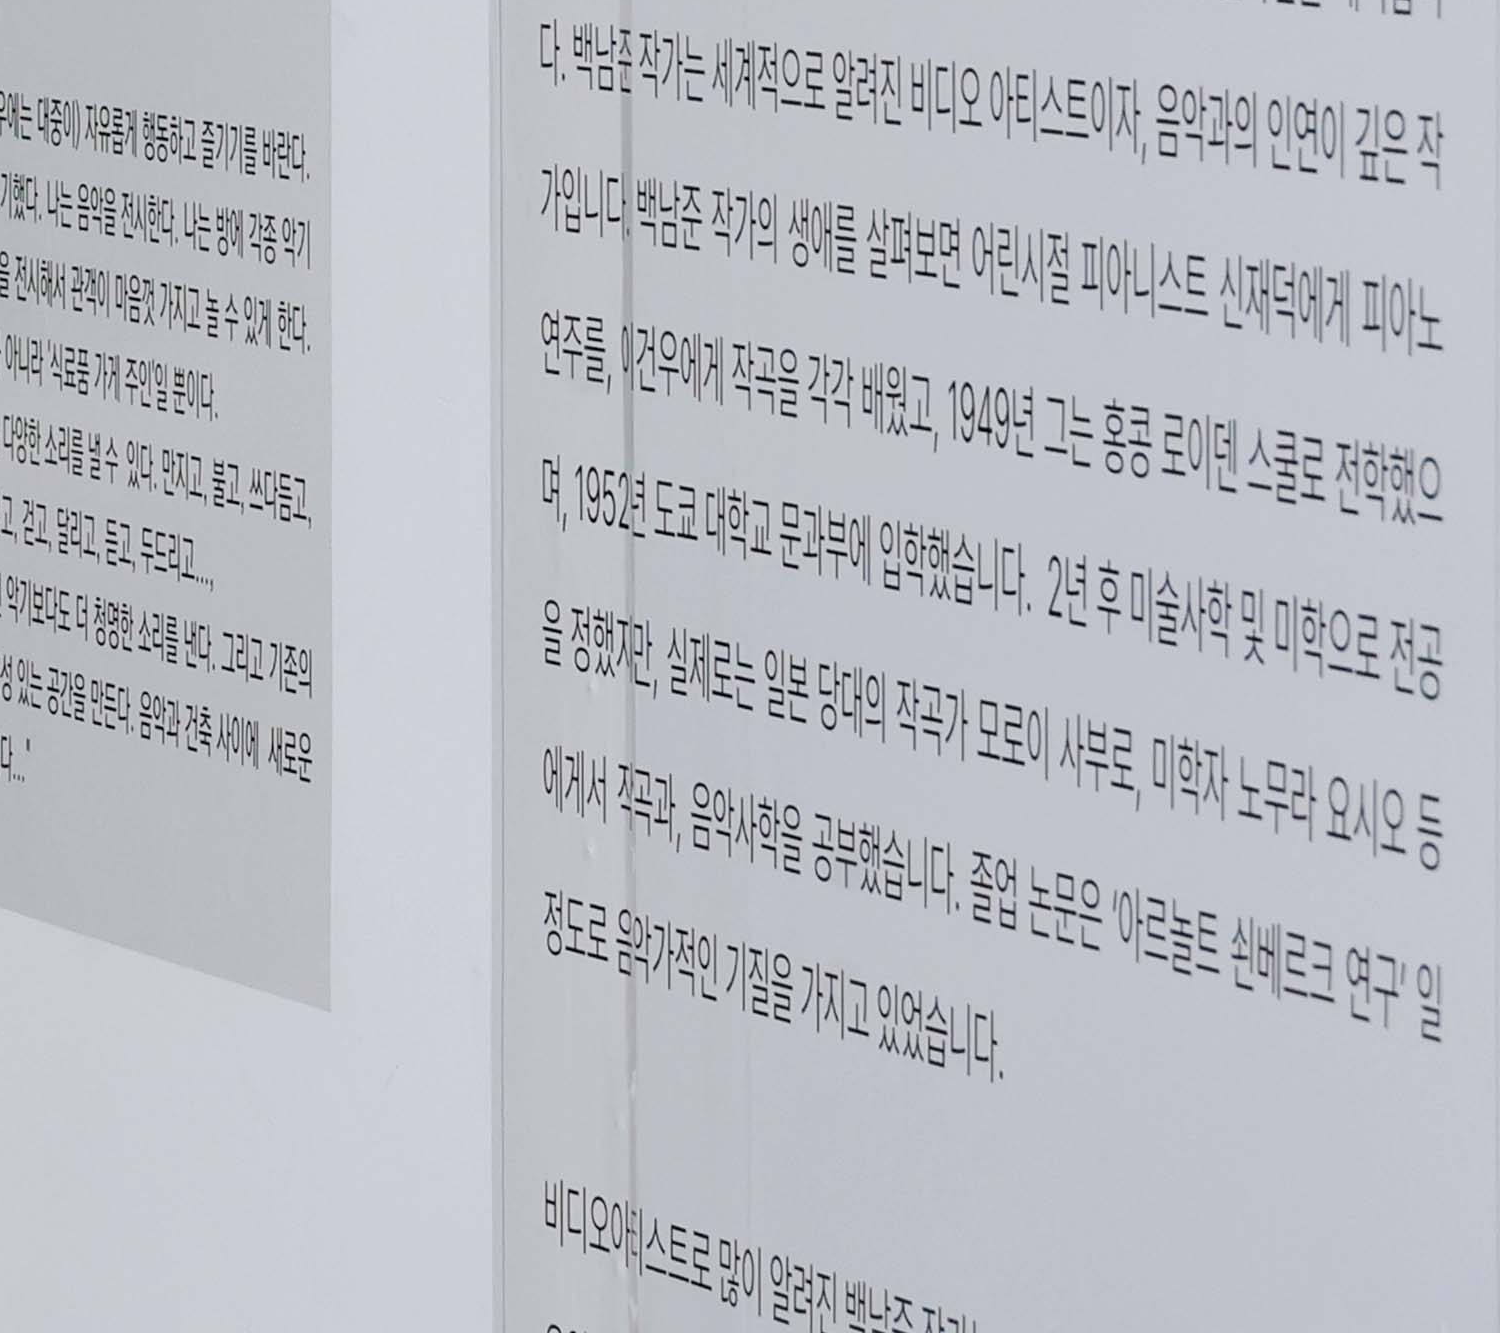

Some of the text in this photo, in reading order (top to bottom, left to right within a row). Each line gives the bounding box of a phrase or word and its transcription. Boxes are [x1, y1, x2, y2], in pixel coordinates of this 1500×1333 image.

[540, 19, 1444, 189] 다. 백남준 작가는 세계적으로 알려진 비디오 아티스트이자, 음악과의 인연이 깊은 작
[47, 180, 73, 229] 나는
[76, 183, 118, 237] 음악을
[184, 201, 211, 252] 나는
[216, 207, 243, 259] 방에
[248, 213, 278, 264] 각종
[282, 217, 310, 269] 악기
[637, 178, 703, 251] 백남준
[712, 187, 777, 264] 작가의
[788, 198, 857, 275] 생애를
[866, 208, 960, 289] 살펴보면
[972, 222, 1070, 305] 어린시절
[1081, 237, 1209, 318] 피아니스트
[1220, 256, 1349, 347] 신재덕에게
[1362, 276, 1443, 356] 피아노
[541, 309, 1443, 525] 연주를, 이건우에게 작곡을 각각 배웠고, 1949년 그는 홍콩 로이덴 스쿨로 전학했으
[544, 890, 1003, 1083] 정도로 음악가적인 기질을 가지고 있었습니다.
[719, 1238, 761, 1317] 많이
[770, 1255, 836, 1333] 알려진
